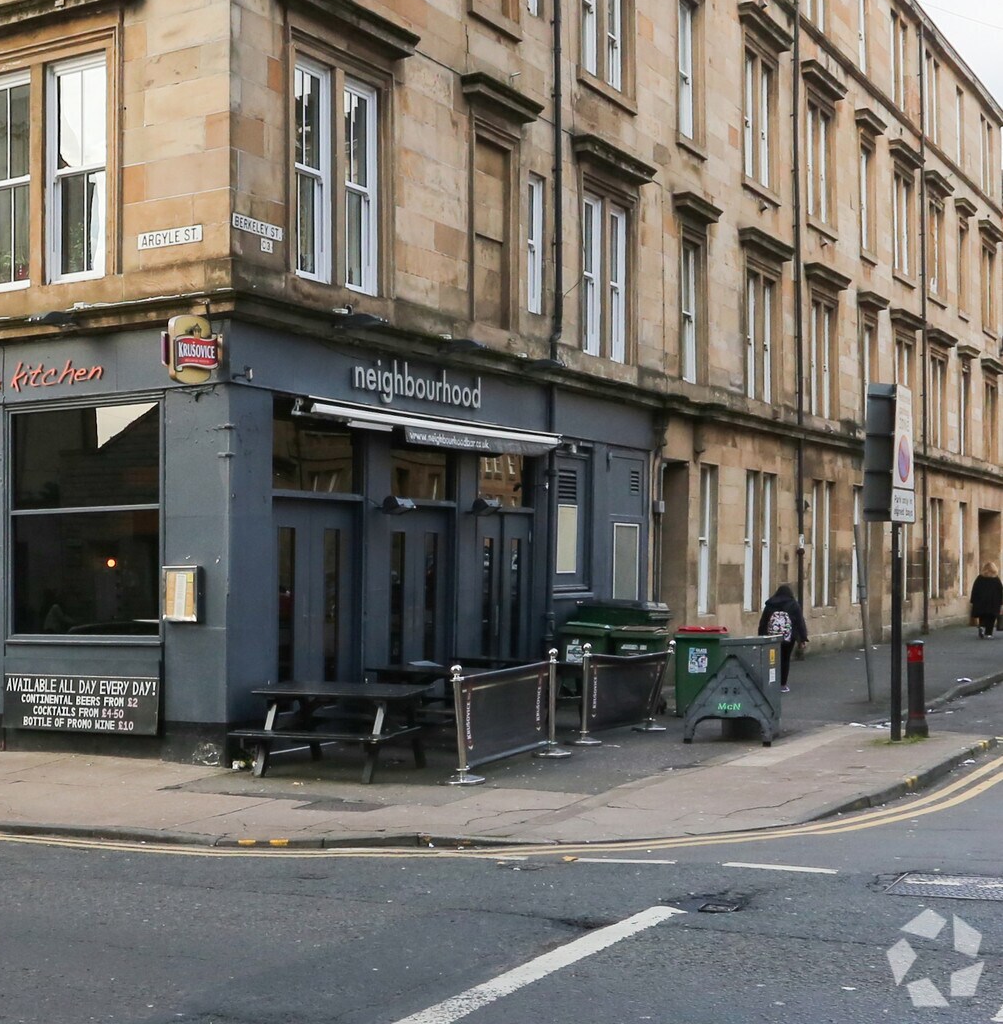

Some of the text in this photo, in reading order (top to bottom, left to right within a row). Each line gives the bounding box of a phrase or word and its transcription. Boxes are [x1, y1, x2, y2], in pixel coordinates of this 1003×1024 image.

[234, 215, 281, 239] BERKELEY ST.
[141, 227, 199, 248] ARGYLE ST.
[178, 341, 216, 359] KRUŠOVICE
[11, 359, 103, 393] kitchen
[354, 359, 482, 409] neighbourhood
[6, 677, 157, 696] AVAILABLE ALL DAY EVERY DAY!
[21, 693, 139, 708] CONTINENTAL BEERS FROM £2
[717, 702, 742, 711] McN
[32, 705, 76, 717] COCKTAILS
[78, 707, 99, 718] FROM
[23, 716, 134, 731] BOTTLE OF PROMO WINE £10
